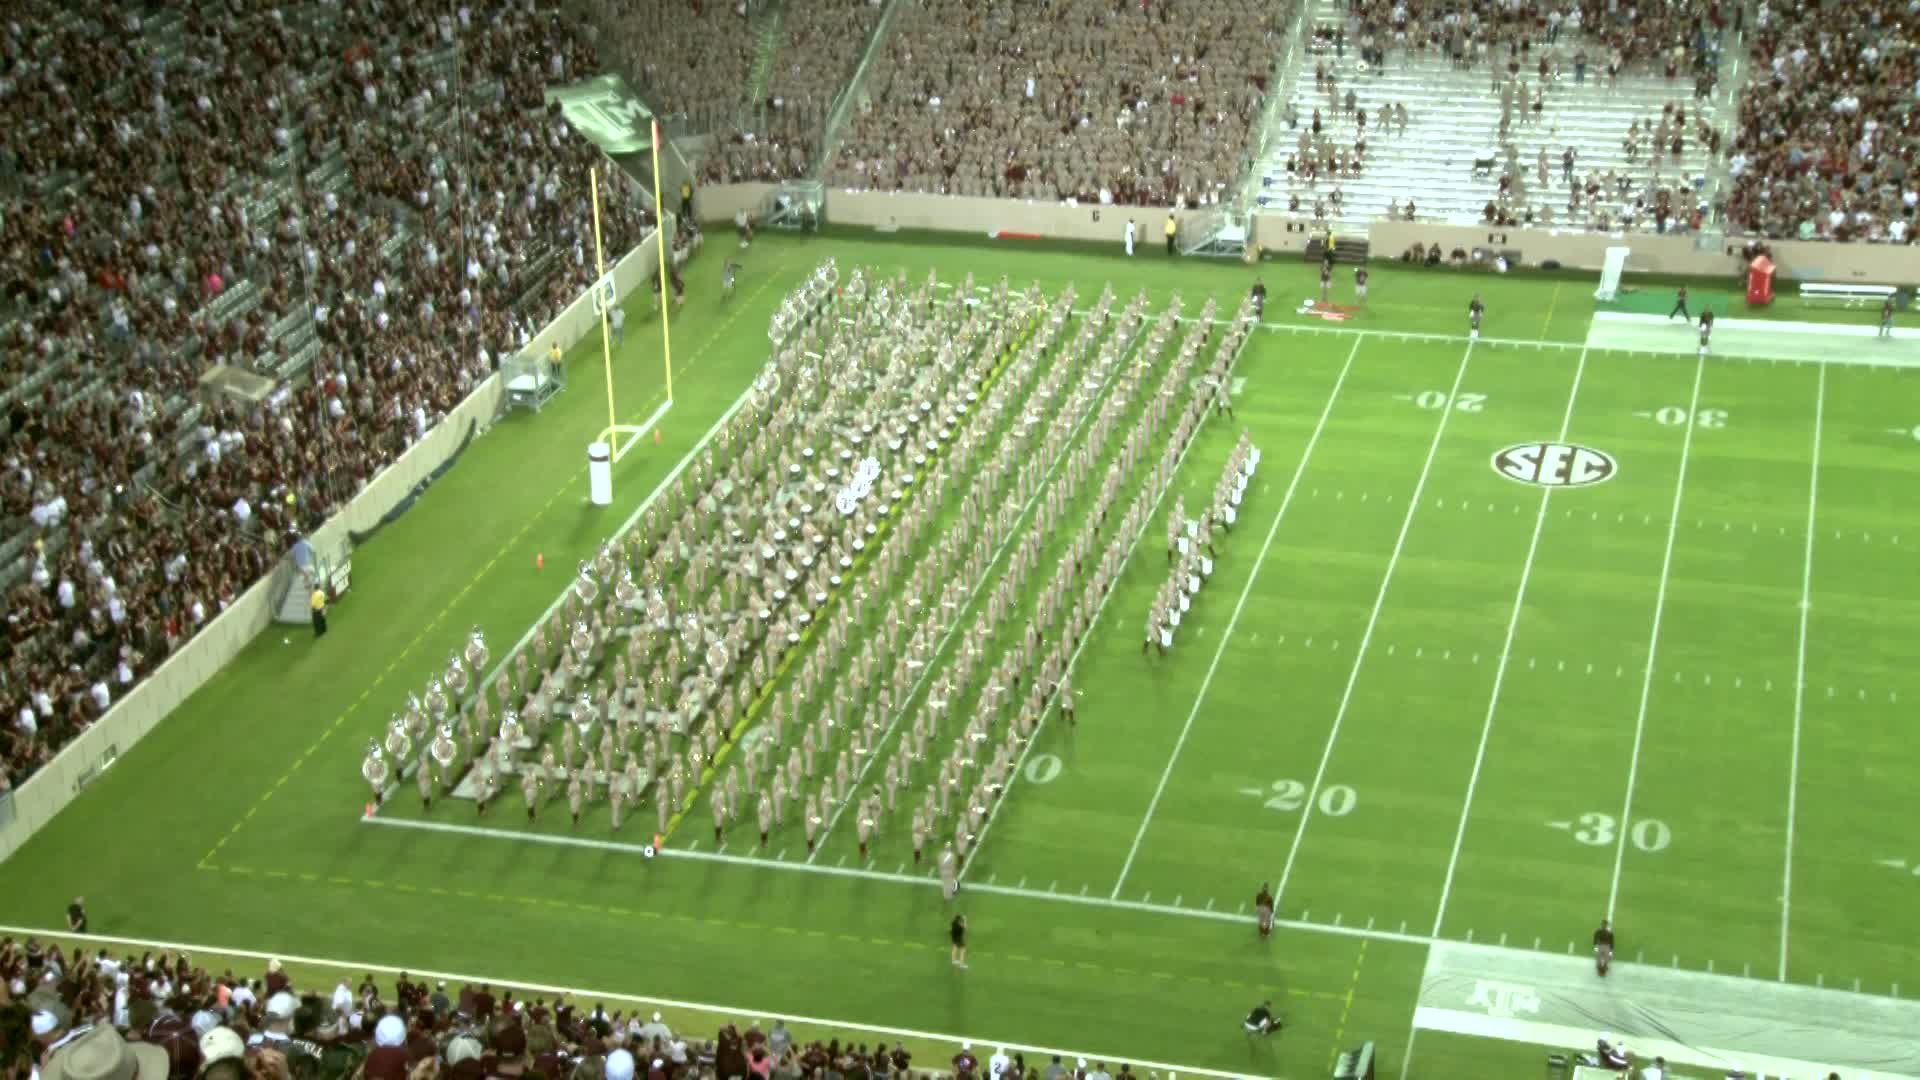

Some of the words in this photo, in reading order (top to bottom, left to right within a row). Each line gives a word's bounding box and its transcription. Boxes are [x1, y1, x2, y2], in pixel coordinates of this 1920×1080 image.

[1503, 444, 1606, 485] SEC
[1263, 778, 1357, 816] 20
[1575, 812, 1671, 851] 30
